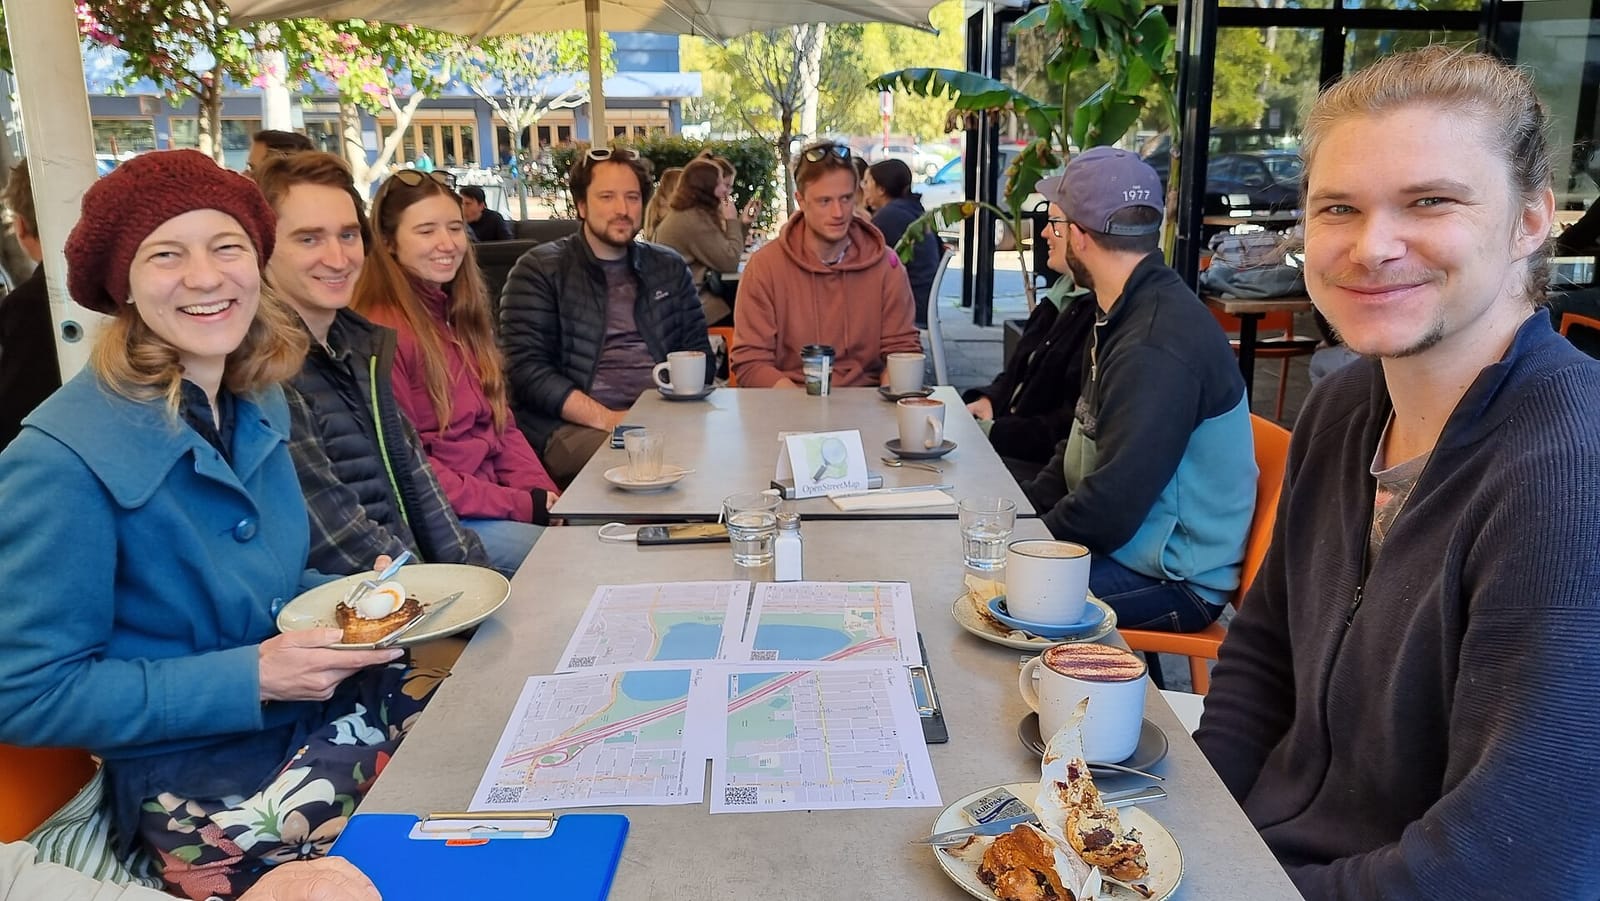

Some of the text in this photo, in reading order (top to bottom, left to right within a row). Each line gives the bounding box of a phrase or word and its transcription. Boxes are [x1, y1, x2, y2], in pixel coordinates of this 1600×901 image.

[1122, 190, 1150, 202] 1977
[802, 480, 861, 496] OpenStreetMap
[974, 795, 1006, 815] LURPAK
